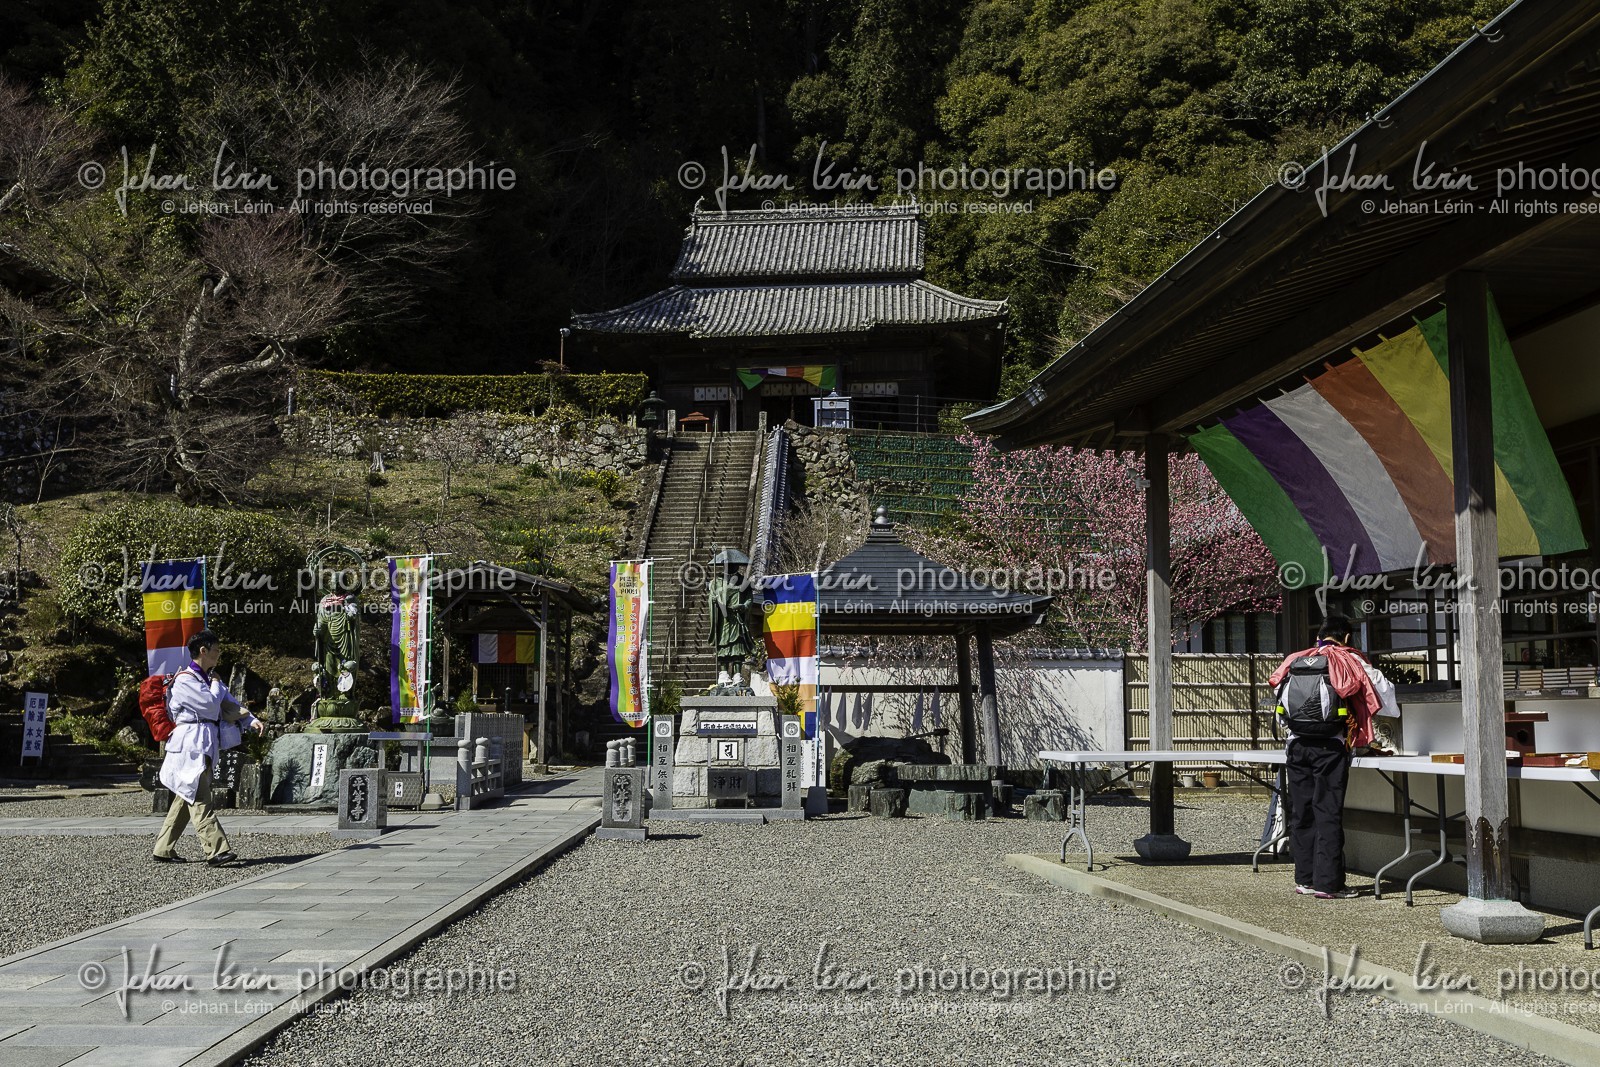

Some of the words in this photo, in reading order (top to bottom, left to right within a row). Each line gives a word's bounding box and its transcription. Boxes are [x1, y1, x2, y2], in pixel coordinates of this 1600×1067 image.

[24, 698, 36, 750] 厄除本堂
[350, 777, 366, 820] 平等寺
[616, 775, 630, 820] 平等寺
